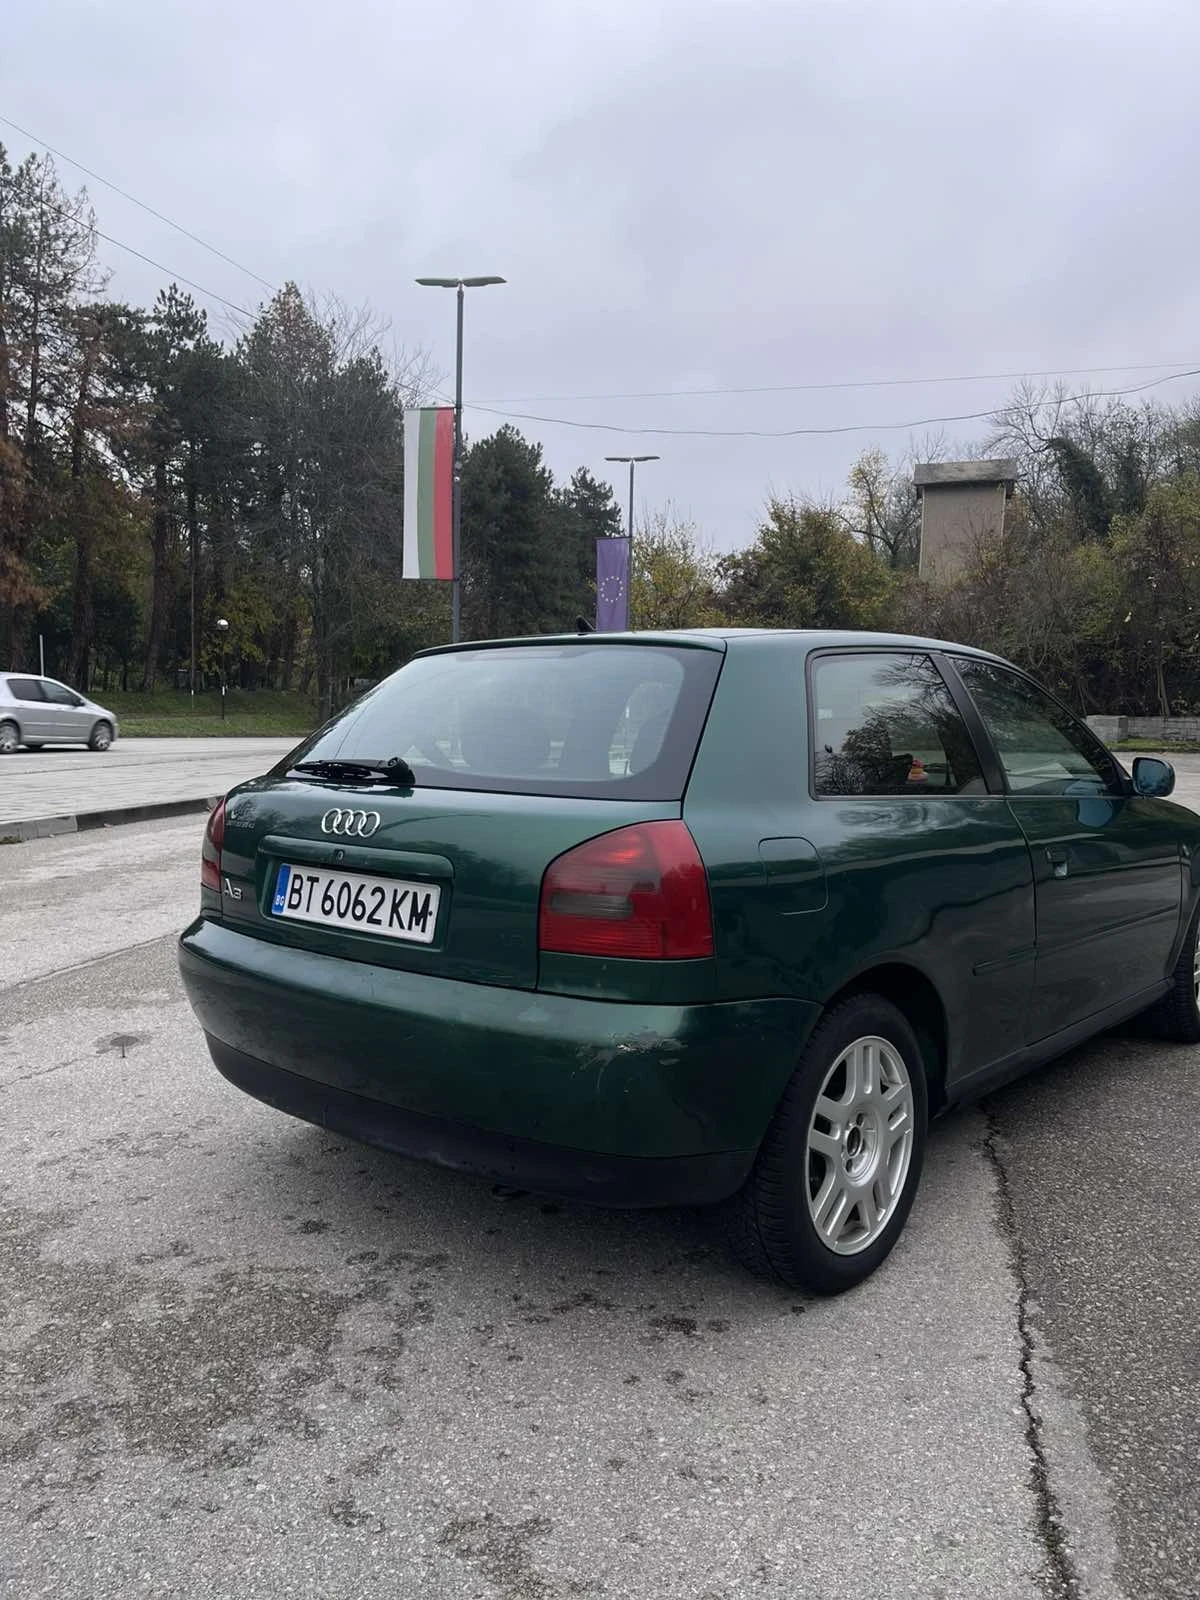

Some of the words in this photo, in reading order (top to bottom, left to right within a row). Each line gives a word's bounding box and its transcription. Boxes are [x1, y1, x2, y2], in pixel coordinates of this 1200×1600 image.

[287, 873, 320, 913] BT
[321, 879, 386, 925] 6062
[388, 888, 431, 933] KM
